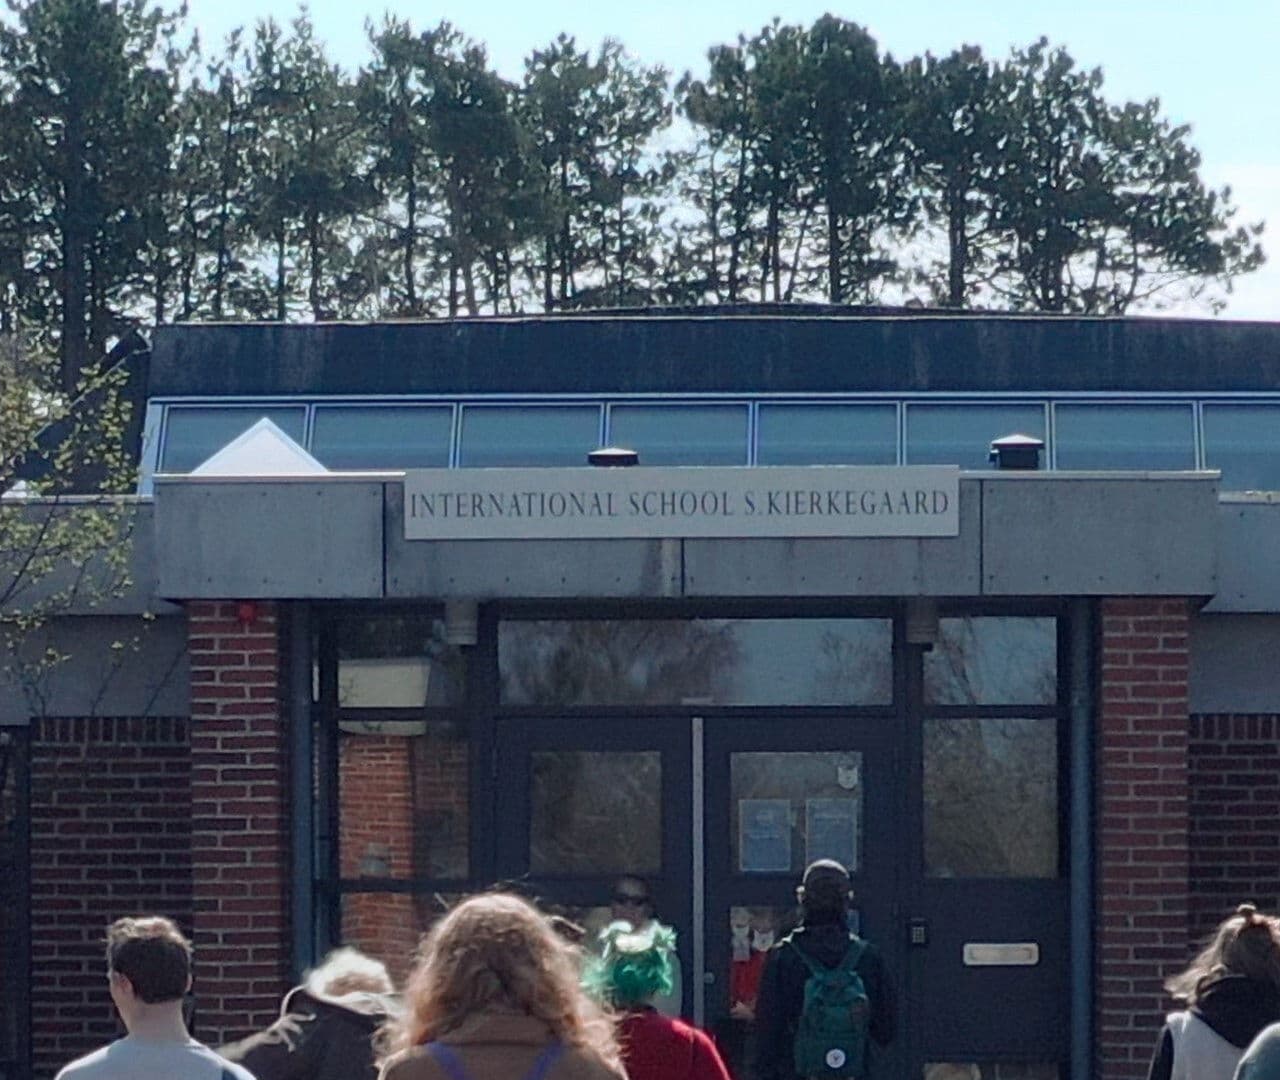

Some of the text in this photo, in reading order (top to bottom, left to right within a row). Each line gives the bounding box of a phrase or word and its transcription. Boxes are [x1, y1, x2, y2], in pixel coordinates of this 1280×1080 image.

[411, 492, 618, 518] INTERNATIONAL
[629, 491, 734, 517] SCHOOL
[767, 490, 949, 516] KIERKEGAARD
